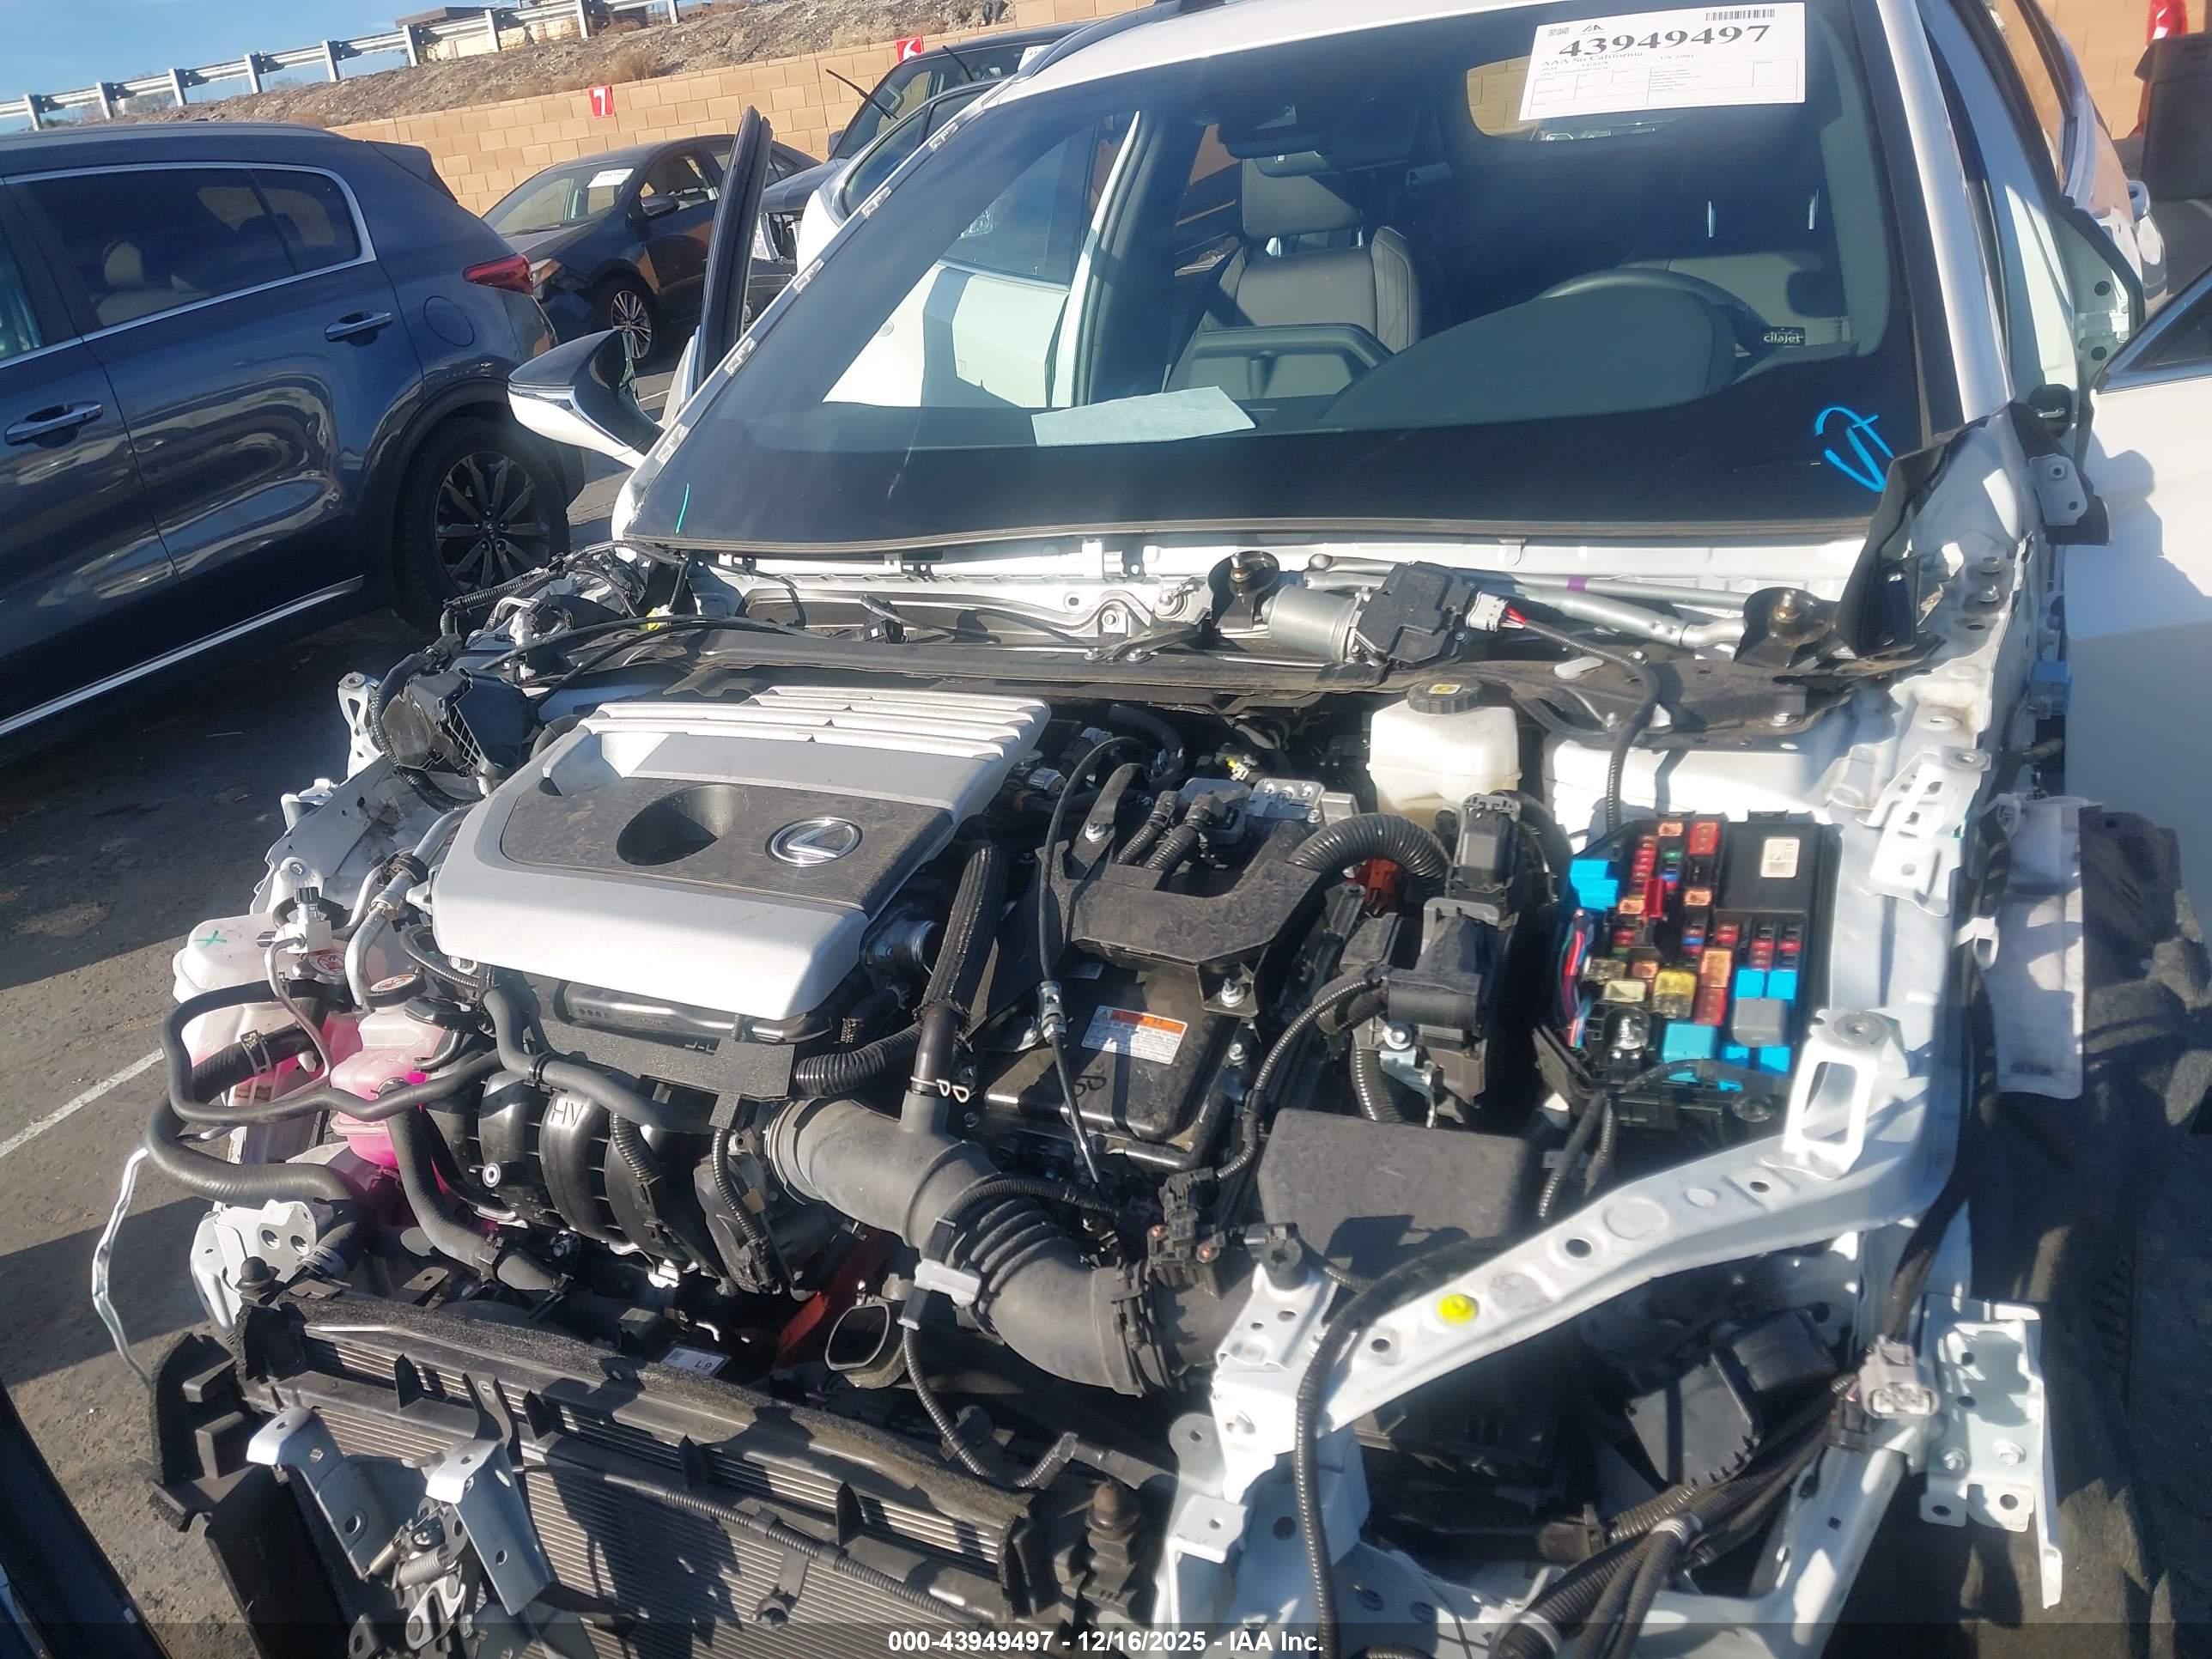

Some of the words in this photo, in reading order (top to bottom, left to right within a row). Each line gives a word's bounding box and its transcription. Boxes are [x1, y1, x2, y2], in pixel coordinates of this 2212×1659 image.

[1559, 25, 1771, 56] 43949497
[1763, 331, 1802, 344] cilajet
[550, 1098, 584, 1127] HV
